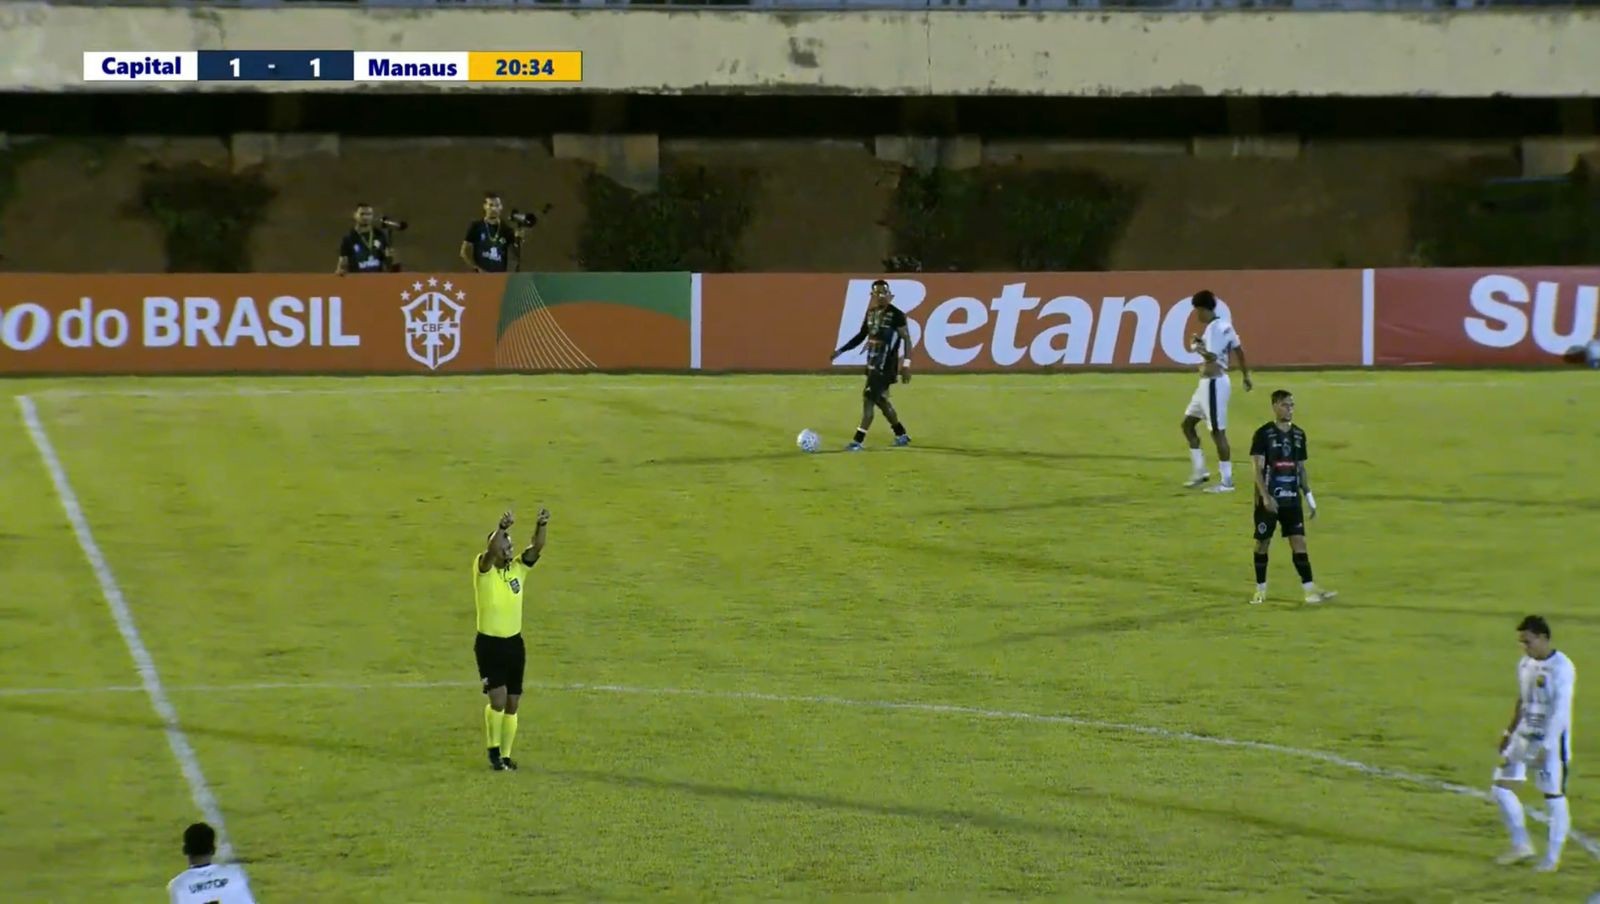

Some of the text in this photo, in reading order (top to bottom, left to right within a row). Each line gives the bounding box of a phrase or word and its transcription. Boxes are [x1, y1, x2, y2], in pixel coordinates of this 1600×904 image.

[0, 295, 361, 351] o do BRASIL
[421, 323, 444, 333] CBF
